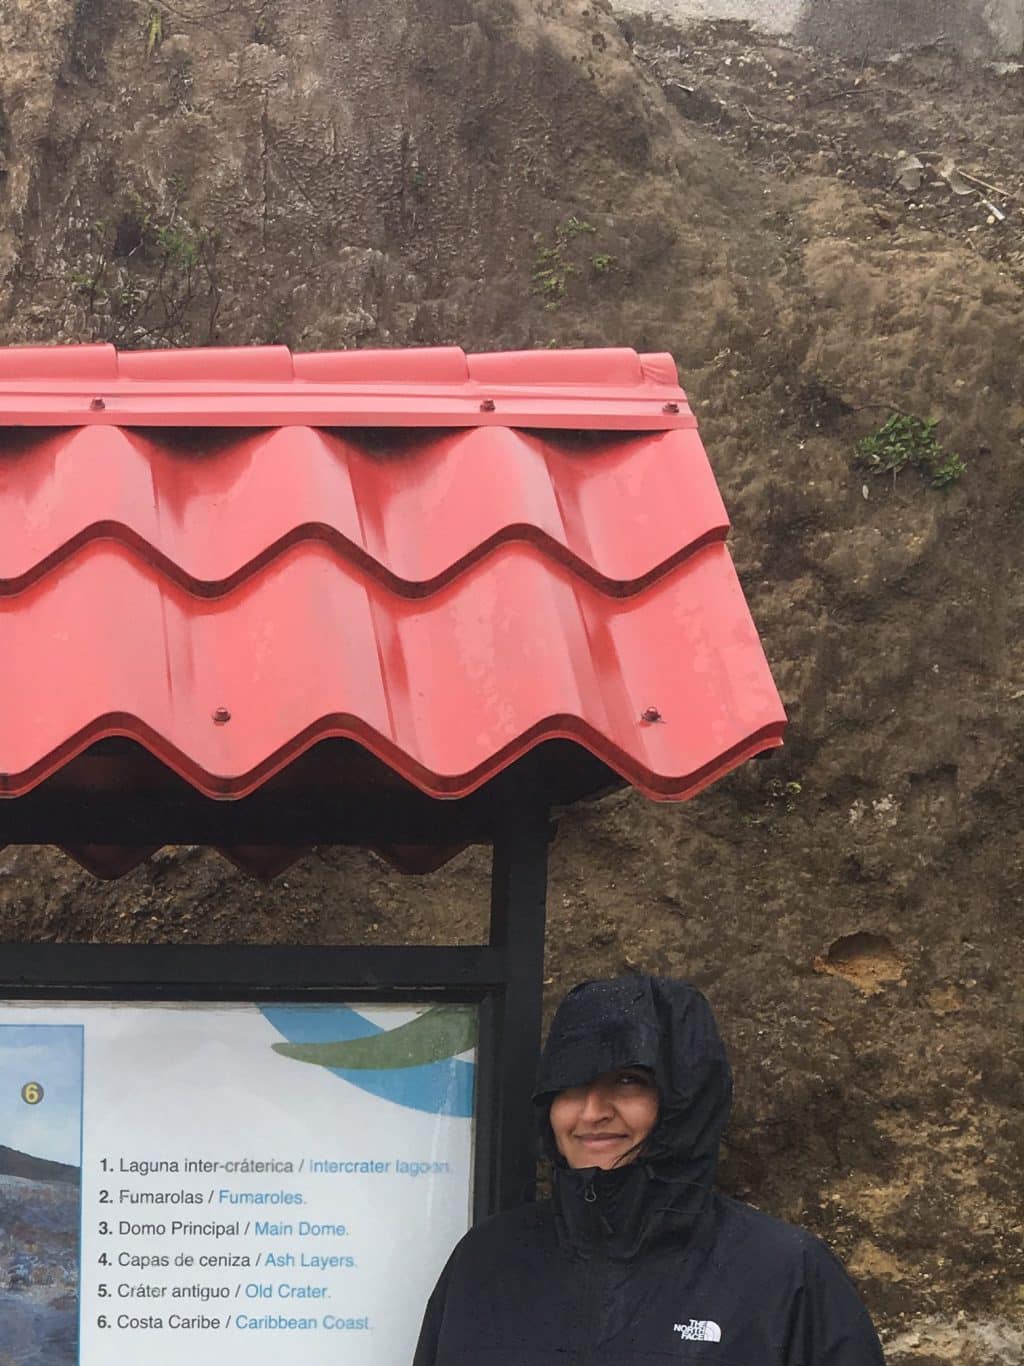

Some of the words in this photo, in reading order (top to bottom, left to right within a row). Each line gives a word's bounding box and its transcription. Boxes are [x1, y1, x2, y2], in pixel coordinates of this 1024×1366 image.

[26, 1085, 39, 1102] 6
[100, 1157, 115, 1172] 1.
[119, 1157, 180, 1177] Laguna
[184, 1157, 294, 1174] inter-cráterica
[309, 1158, 391, 1174] Intercrater
[99, 1189, 114, 1204] 2.
[119, 1189, 204, 1205] Fumarolas
[219, 1189, 307, 1205] Fumaroles.
[98, 1221, 113, 1235] 3.
[118, 1221, 166, 1236] Domo
[171, 1220, 240, 1239] Principal
[255, 1220, 293, 1236] Main
[299, 1220, 349, 1236] Dome.
[98, 1252, 113, 1267] 4.
[118, 1252, 170, 1271] Capas
[174, 1252, 194, 1267] de
[199, 1252, 251, 1267] ceniza
[265, 1252, 295, 1267] Ash
[97, 1284, 112, 1298] 5.
[117, 1283, 167, 1298] Cráter
[171, 1283, 231, 1301] antiguo
[245, 1283, 272, 1298] Old
[277, 1283, 332, 1299] Crater.
[97, 1315, 112, 1329] 6.
[117, 1314, 163, 1330] Costa
[168, 1314, 221, 1330] Caribe
[235, 1314, 317, 1330] Caribbean
[673, 1323, 705, 1335] NORTH
[688, 1318, 705, 1328] THE
[680, 1331, 705, 1341] FACE
